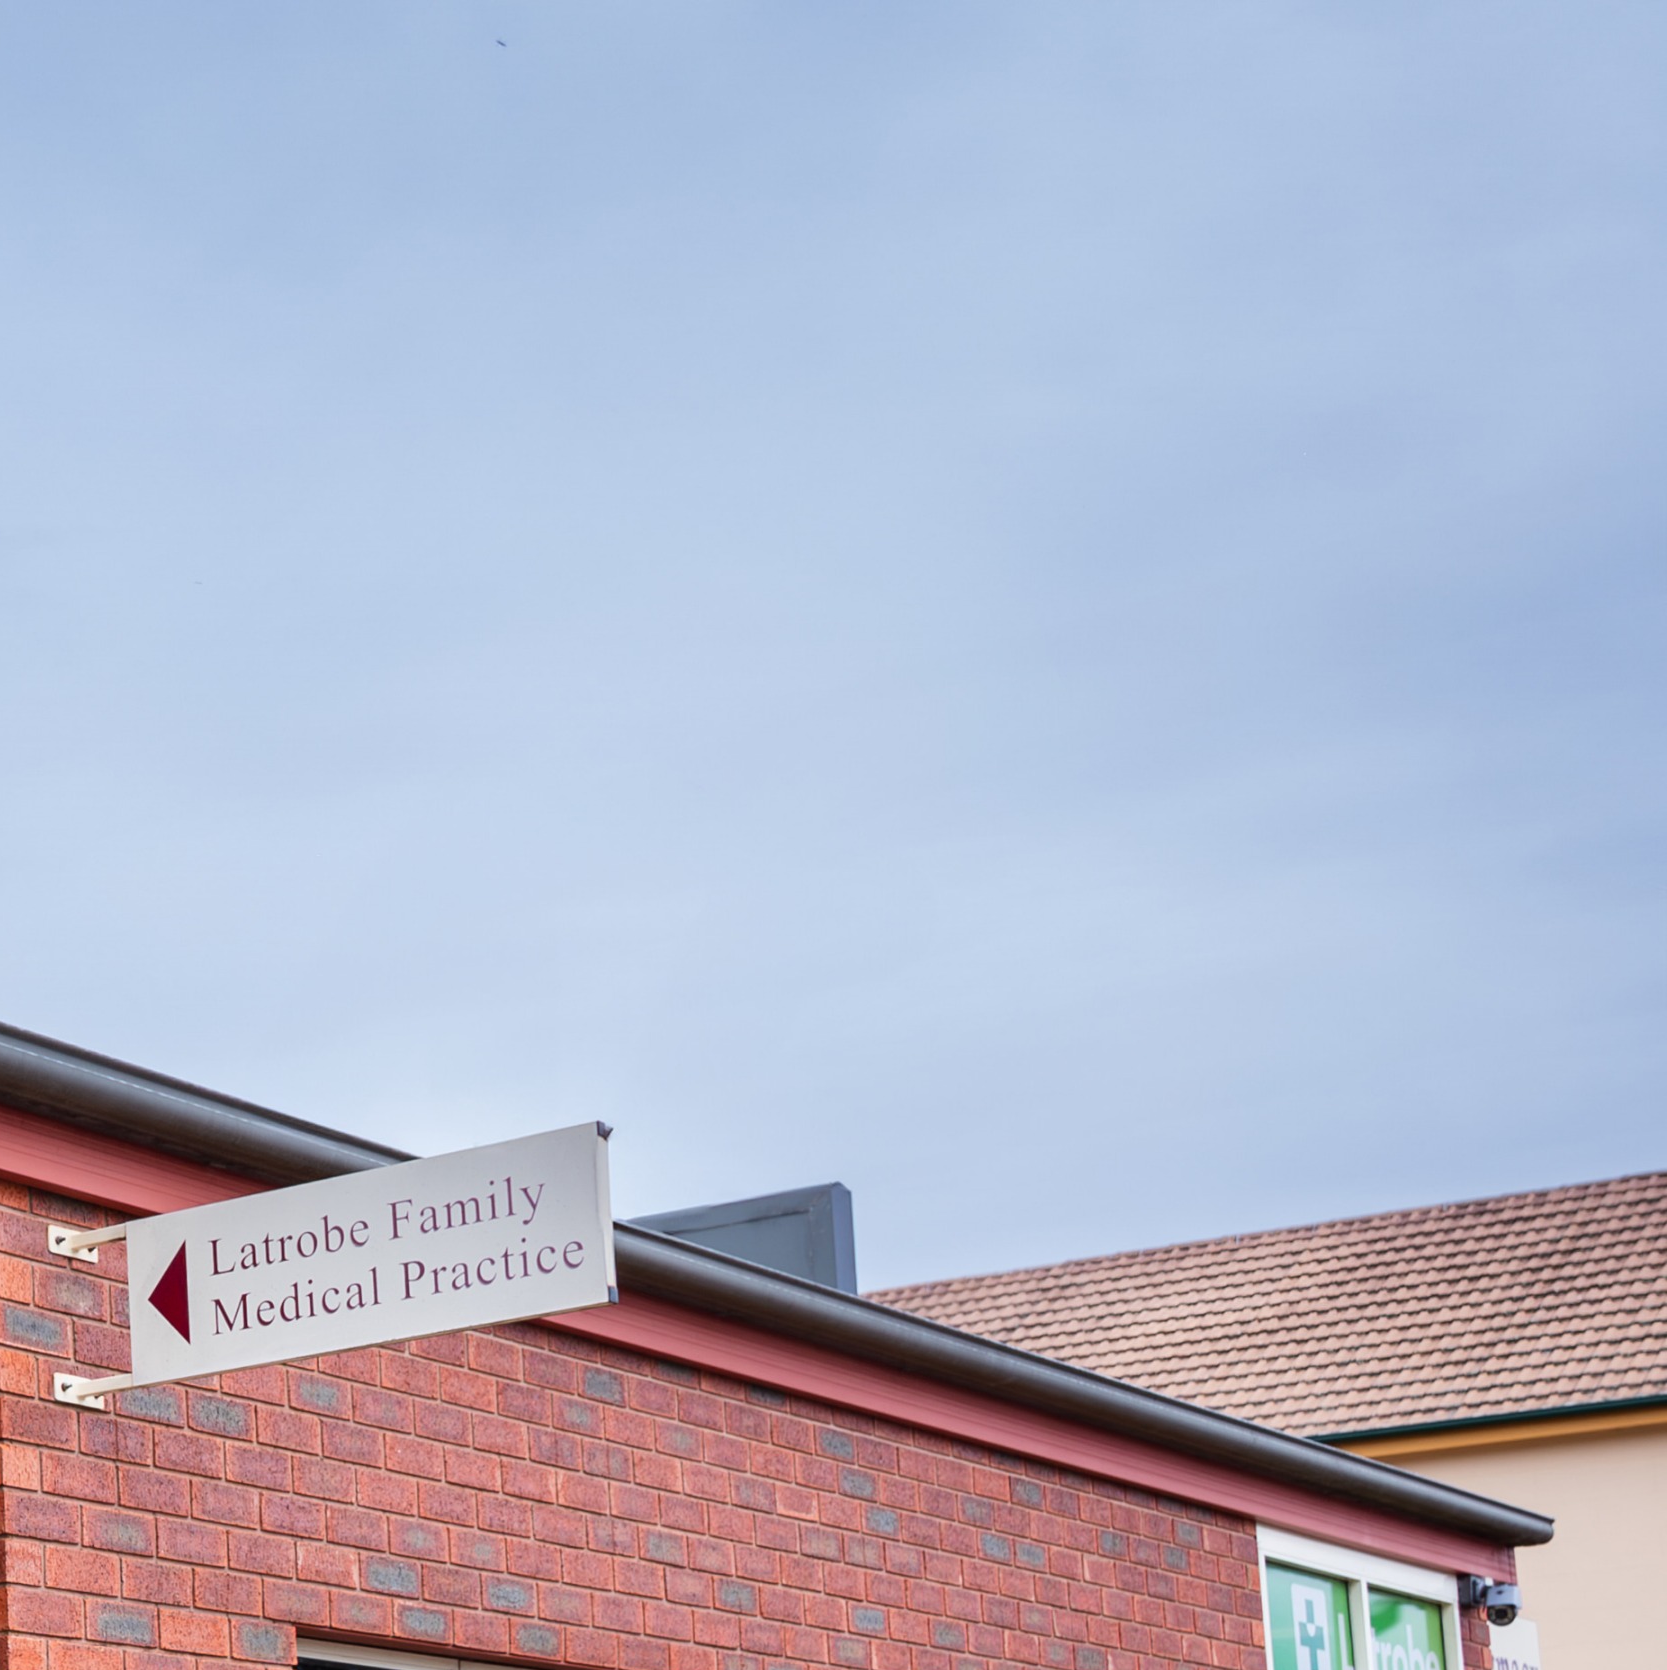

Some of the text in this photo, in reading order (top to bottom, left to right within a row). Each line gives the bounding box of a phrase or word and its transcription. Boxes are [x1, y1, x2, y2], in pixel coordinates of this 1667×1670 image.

[208, 1176, 546, 1277] Latrobe Family
[211, 1238, 585, 1336] Medical Practice
